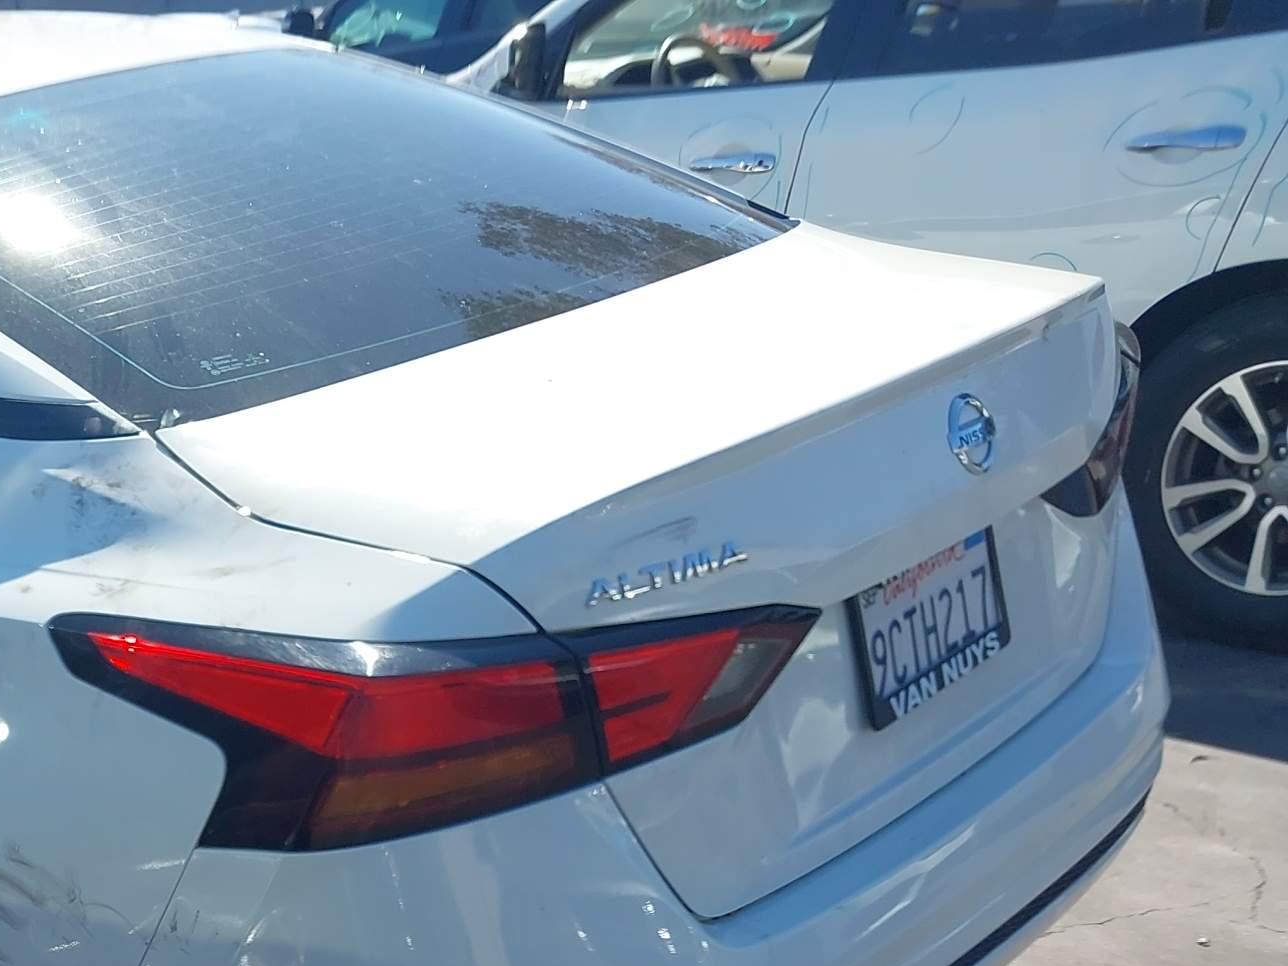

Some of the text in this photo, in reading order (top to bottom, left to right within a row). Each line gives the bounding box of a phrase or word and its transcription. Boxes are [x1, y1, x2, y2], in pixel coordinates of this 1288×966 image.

[584, 541, 748, 608] ALTIMA
[871, 564, 987, 699] 9CTH217
[889, 630, 1000, 719] VAN NUYS
